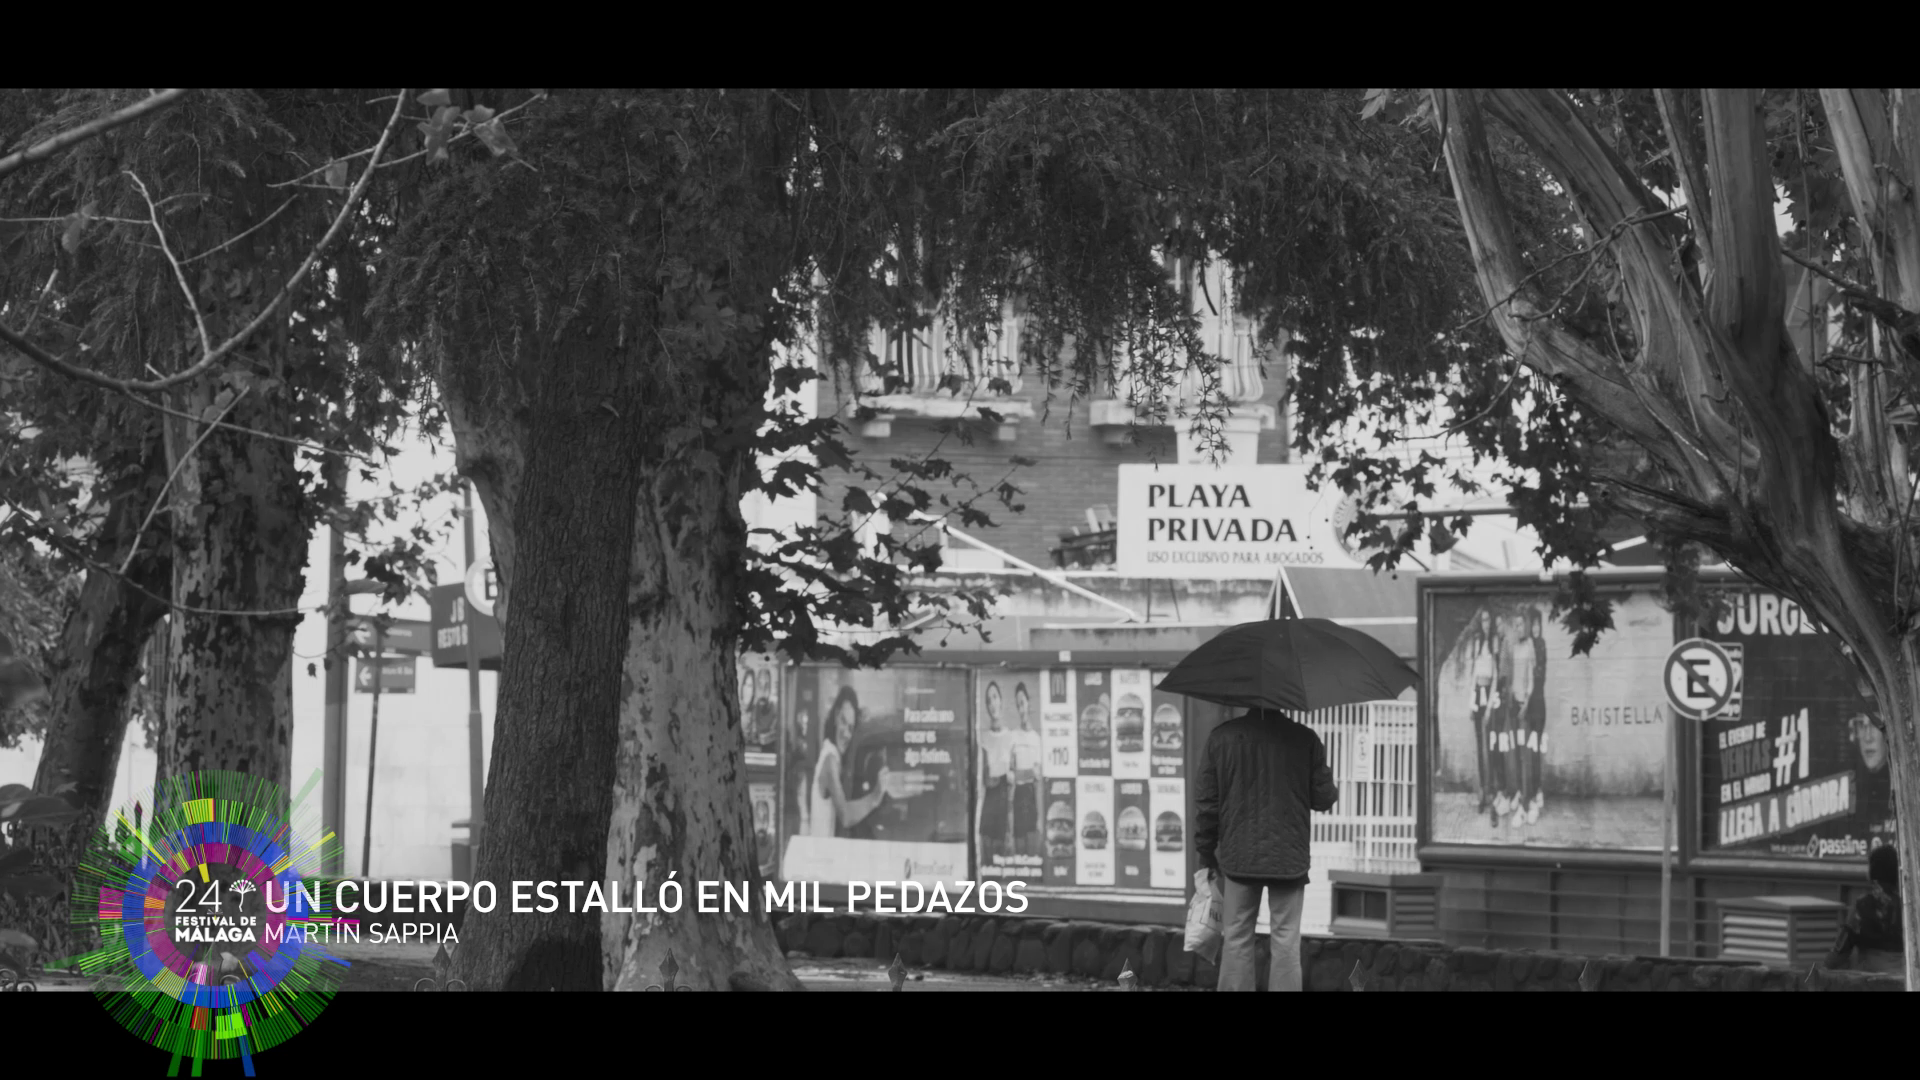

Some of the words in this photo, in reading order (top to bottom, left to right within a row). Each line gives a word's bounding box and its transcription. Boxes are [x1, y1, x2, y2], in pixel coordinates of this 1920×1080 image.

[1147, 484, 1252, 508] PLAYA
[1147, 518, 1297, 542] PRIVADA
[1147, 551, 1169, 563] USO
[1172, 551, 1230, 564] EXCLUSIVO
[1233, 552, 1260, 564] PARA
[1264, 552, 1324, 565] ABOGADOS
[1687, 659, 1711, 698] E
[1570, 706, 1664, 726] BATISTELLA
[1756, 721, 1766, 739] DE
[1720, 739, 1771, 780] VENTAS
[1773, 708, 1810, 787] #1
[1720, 802, 1764, 845] LLEGA
[1768, 798, 1780, 833] A
[1786, 775, 1850, 828] CÓRDOBA
[1819, 834, 1868, 858] passline
